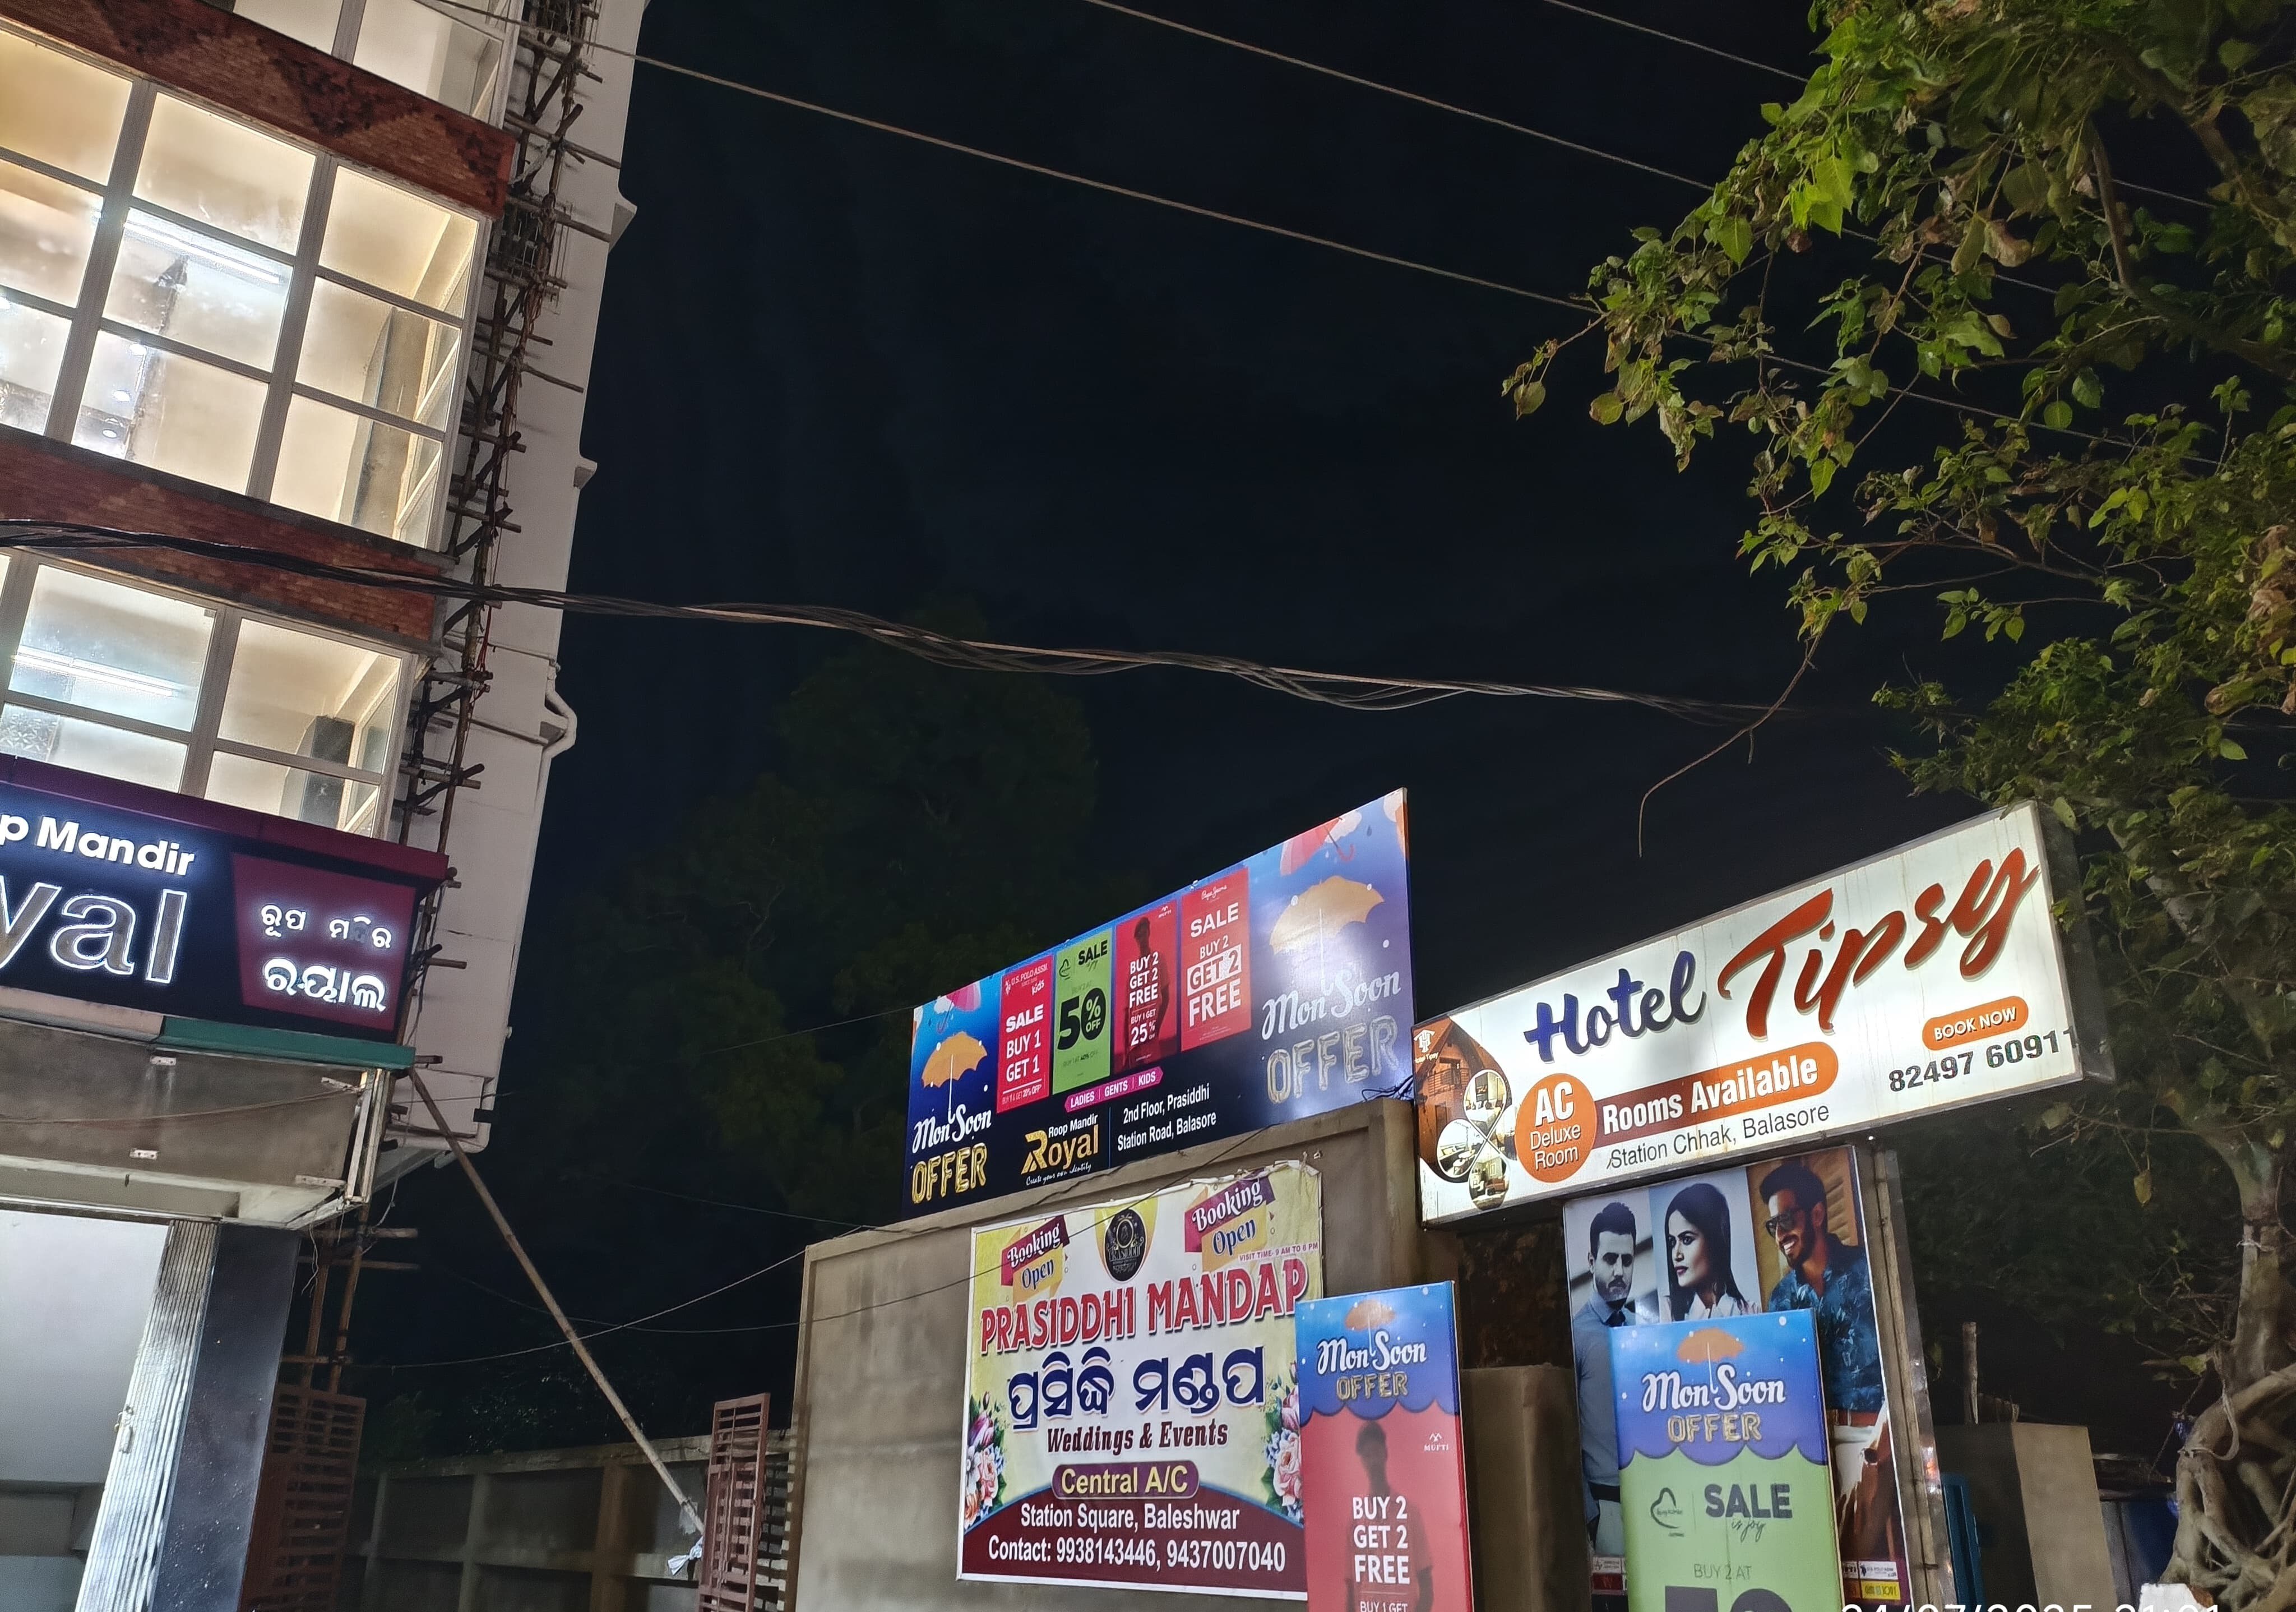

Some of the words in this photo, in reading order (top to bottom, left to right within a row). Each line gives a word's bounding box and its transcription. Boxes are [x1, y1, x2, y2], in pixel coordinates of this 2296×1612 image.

[36, 816, 195, 875] Mandir
[1191, 902, 1239, 937] SALE
[1078, 940, 1108, 965] SALE
[1200, 939, 1220, 959] BUY
[1223, 935, 1229, 949] 2
[1523, 950, 1706, 1064] Hotel
[1718, 847, 2040, 1041] Tipsy
[1021, 969, 1034, 981] POLO
[1130, 954, 1150, 974] BUY
[1152, 952, 1159, 966] 2
[1130, 971, 1150, 989] GET
[1152, 967, 1158, 981] 2
[1190, 956, 1224, 990] GET
[1229, 950, 1238, 974] 2
[1032, 980, 1044, 995] kids
[1130, 982, 1158, 1008] FREE
[1189, 978, 1240, 1027] FREE
[1006, 1004, 1044, 1033] SALE
[1085, 1018, 1101, 1033] OFF
[1131, 1014, 1142, 1024] BUY
[1146, 1009, 1156, 1018] GET
[1934, 1018, 1976, 1042] BOOK
[1980, 1006, 2017, 1030] NOW
[1006, 1033, 1031, 1059] BUY
[1034, 1029, 1041, 1048] 1
[1131, 1023, 1147, 1046] 25
[1006, 1058, 1030, 1082] GET
[1033, 1054, 1039, 1074] 1
[1267, 1015, 1399, 1104] OFFER
[1889, 1051, 1974, 1092] 82497
[1071, 1092, 1095, 1108] LADIES
[1104, 1080, 1128, 1097] GENTS
[1138, 1071, 1156, 1087] KIDS
[1123, 1105, 1139, 1124] 2nd
[1141, 1101, 1165, 1119] Floor,
[1167, 1083, 1210, 1112] Prasiddhi
[1535, 1081, 1574, 1128] AC
[1603, 1091, 1683, 1135] Rooms
[1691, 1055, 1818, 1115] Available
[1048, 1124, 1068, 1138] Roop
[1070, 1113, 1098, 1131] Mandir
[1118, 1130, 1147, 1151] Station
[1150, 1121, 1174, 1143] Road,
[1177, 1112, 1216, 1135] Balasore
[1530, 1124, 1581, 1151] Deluxe
[1611, 1141, 1668, 1169] Station
[1673, 1125, 1736, 1154] Chhak,
[1742, 1103, 1830, 1138] Balasore
[1021, 1124, 1099, 1175] Royal
[1535, 1148, 1579, 1171] Room
[912, 1143, 987, 1203] OFFER
[1026, 1176, 1041, 1186] Create
[1192, 1179, 1261, 1232] Booking
[1007, 1223, 1059, 1268] Booking
[1213, 1219, 1256, 1255] Open
[1239, 1253, 1255, 1261] VISIT
[1021, 1258, 1054, 1290] Open
[980, 1286, 1137, 1355] PRASIDDHI
[1147, 1258, 1309, 1333] MANDAP
[1133, 1346, 1265, 1417] ମଣ୍ଡପ
[1336, 1371, 1408, 1399] OFFER
[1047, 1428, 1133, 1455] Weddings
[1139, 1425, 1152, 1448] &
[1159, 1422, 1228, 1448] Events
[1668, 1412, 1762, 1443] OFFER
[1061, 1467, 1138, 1495] Central
[1145, 1465, 1188, 1493] A/C
[1353, 1496, 1390, 1519] BUY
[1396, 1495, 1408, 1519] 2
[1705, 1484, 1793, 1518] SALE
[1021, 1503, 1072, 1527] Station
[1077, 1503, 1138, 1533] Square,
[1144, 1503, 1240, 1530] Baleshwar
[1354, 1525, 1390, 1549] GET
[1396, 1525, 1408, 1549] 2
[988, 1535, 1051, 1562] Contact:
[1057, 1535, 1160, 1571] 9938143446,
[1167, 1540, 1286, 1572] 9437007040
[1354, 1555, 1410, 1585] FREE
[1694, 1563, 1720, 1579] BUY
[1725, 1564, 1732, 1579] 2
[1736, 1565, 1752, 1579] AT
[1360, 1601, 1380, 1612] BUY
